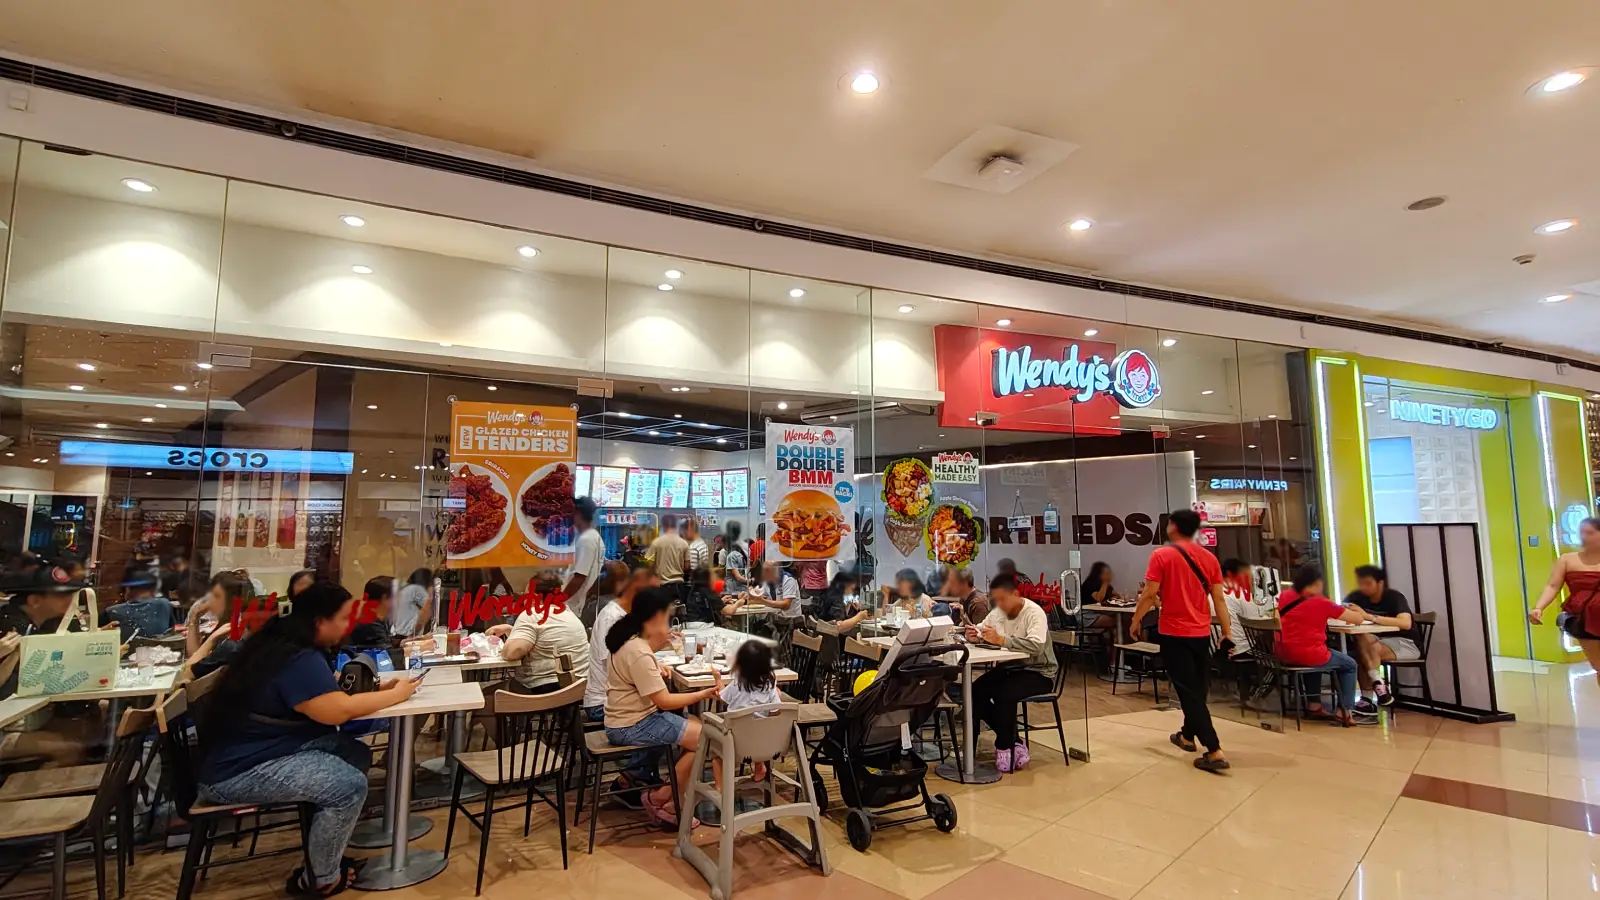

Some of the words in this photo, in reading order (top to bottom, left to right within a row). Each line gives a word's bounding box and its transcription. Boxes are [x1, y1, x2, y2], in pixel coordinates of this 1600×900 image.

[996, 344, 1111, 402] Wendy's
[487, 410, 527, 426] Wendy's
[463, 429, 471, 447] NEW
[475, 427, 519, 436] GLAZED
[521, 428, 569, 438] CHICKEN
[784, 428, 820, 444] Wendy's
[475, 435, 569, 452] TENDERS
[777, 444, 844, 460] DOUBLE
[938, 451, 963, 463] Wendy's
[777, 457, 844, 473] DOUBLE
[934, 464, 977, 475] HEALTHY
[789, 469, 833, 484] BMM
[934, 473, 956, 481] MADE
[958, 474, 977, 482] EASY
[447, 579, 570, 630] Wendy's
